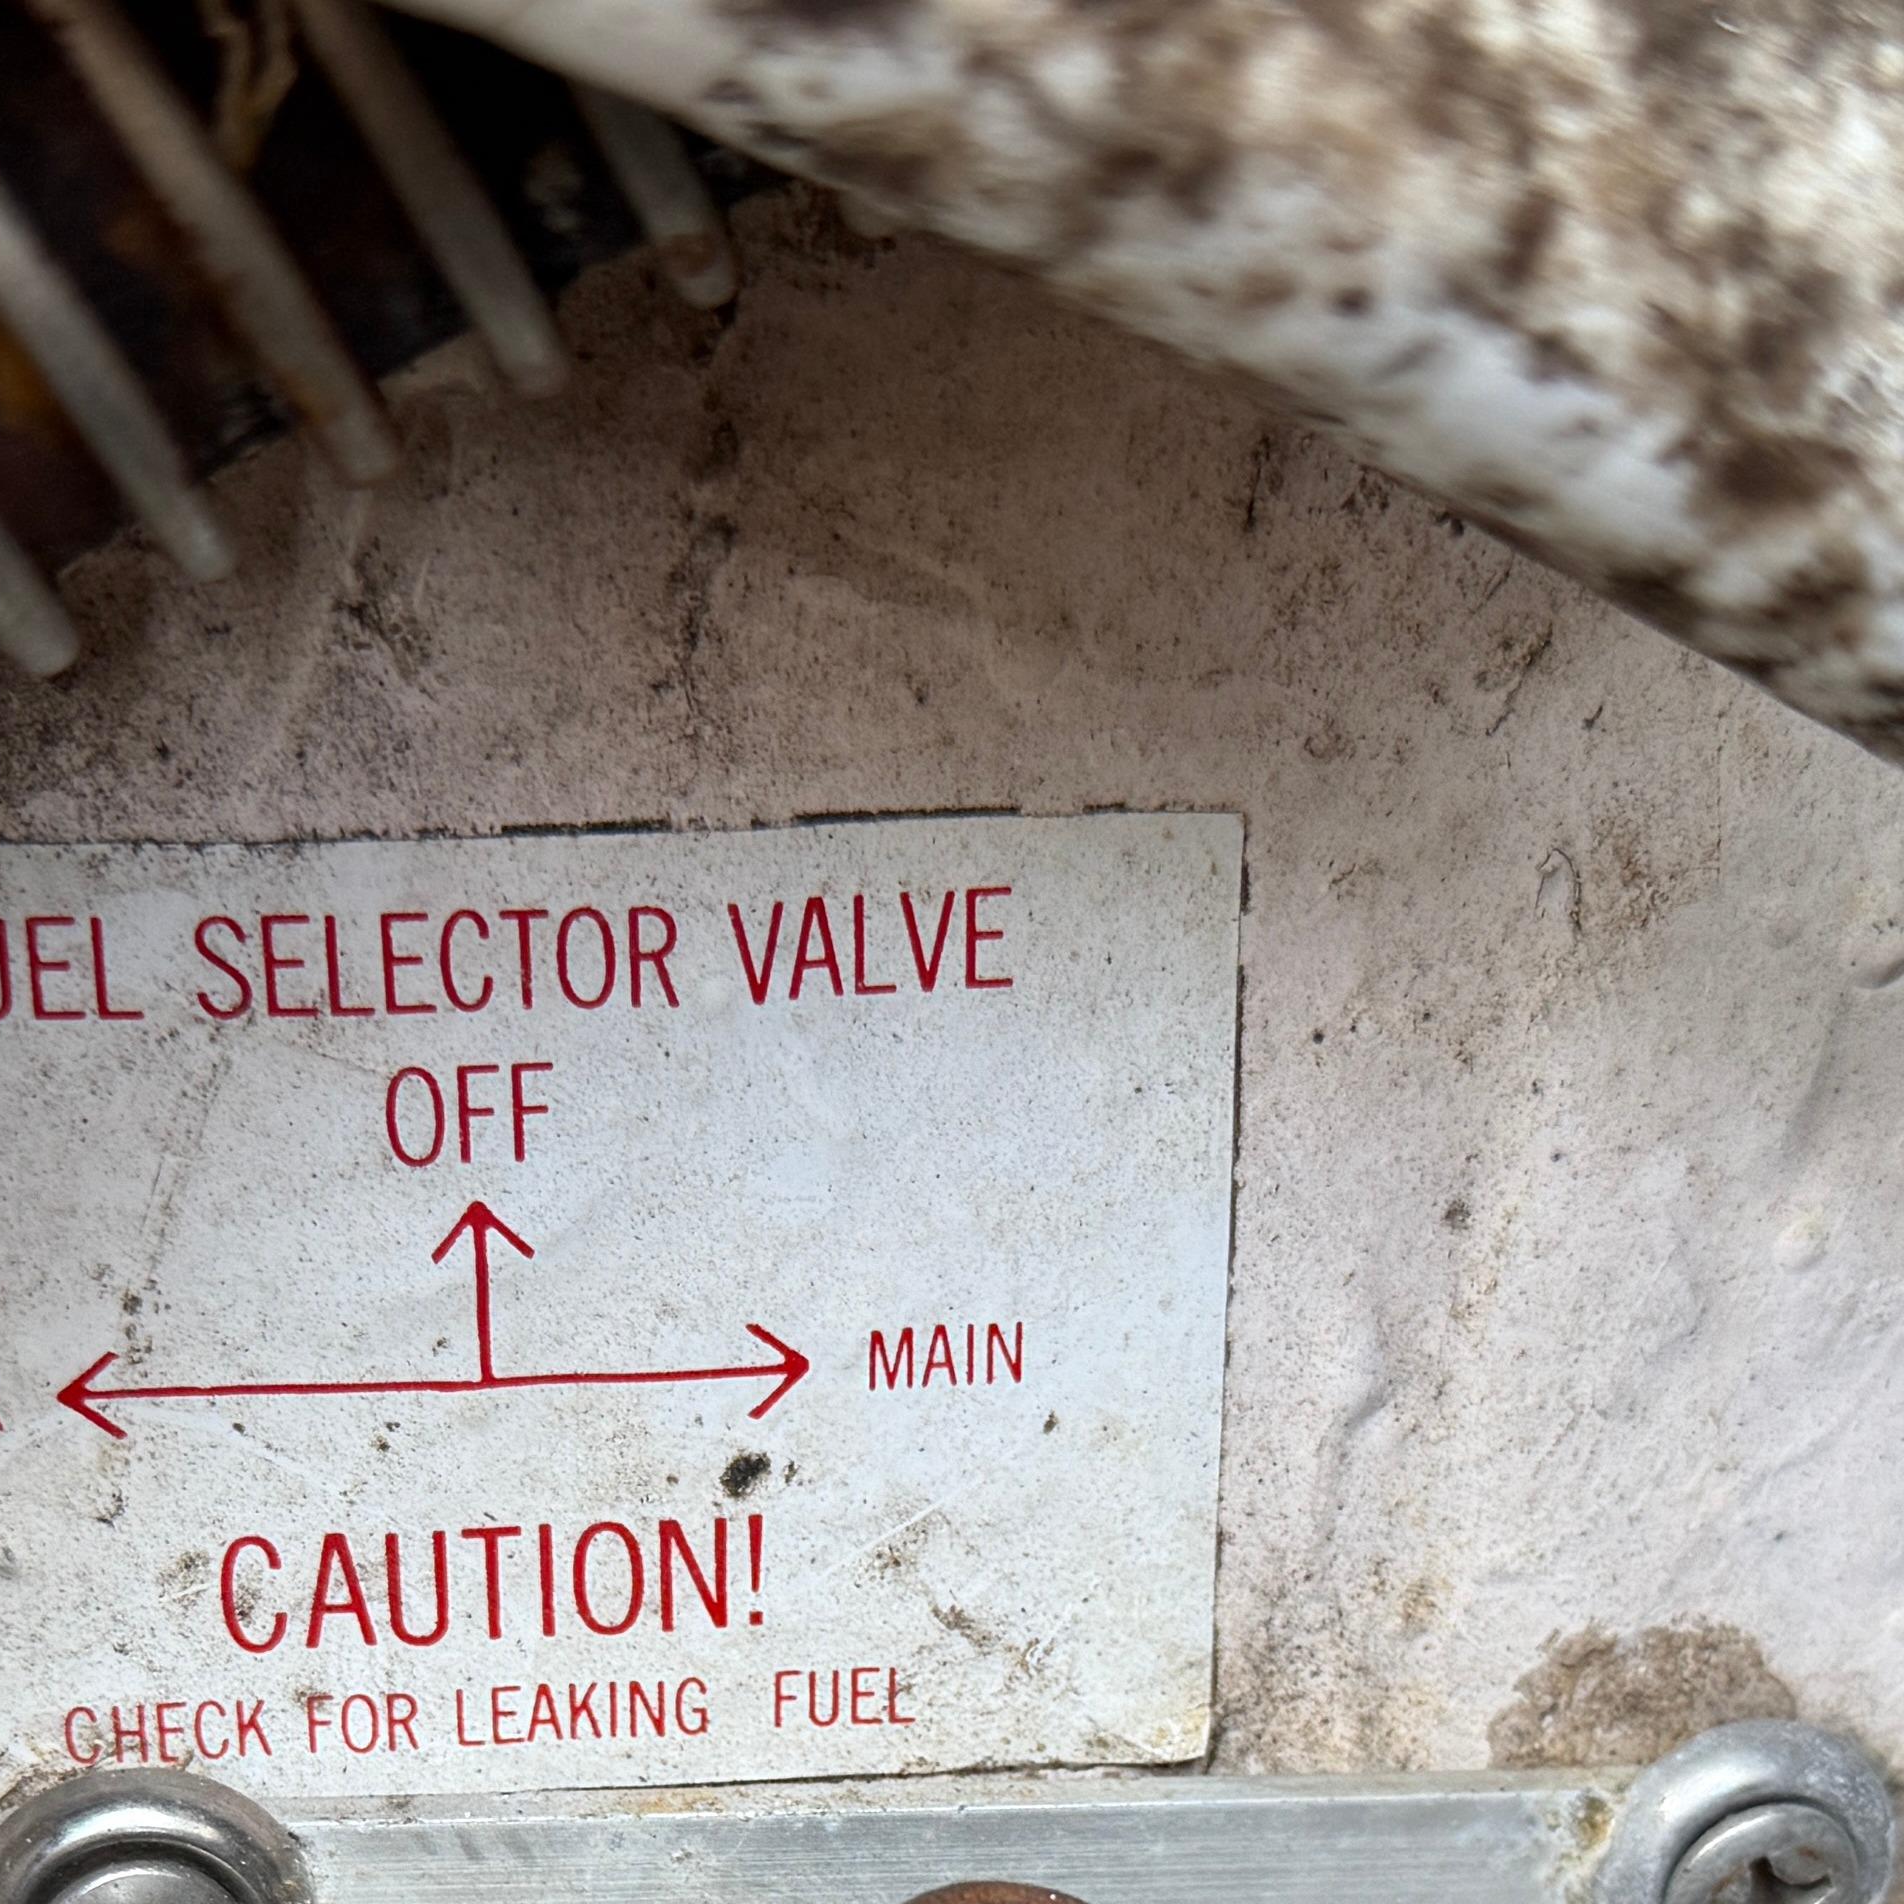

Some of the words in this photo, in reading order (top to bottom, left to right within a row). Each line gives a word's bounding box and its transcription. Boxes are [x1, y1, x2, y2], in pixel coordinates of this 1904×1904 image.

[193, 904, 680, 1020] SELECTOR
[727, 883, 1014, 1006] VALVE
[384, 1061, 554, 1168] OFF
[867, 1321, 1026, 1392] MAIN
[217, 1512, 766, 1656] CAUTION!
[62, 1699, 274, 1767] CHECK
[305, 1691, 421, 1756] FOR
[454, 1676, 711, 1750] LEAKING
[772, 1665, 916, 1730] FUEL
